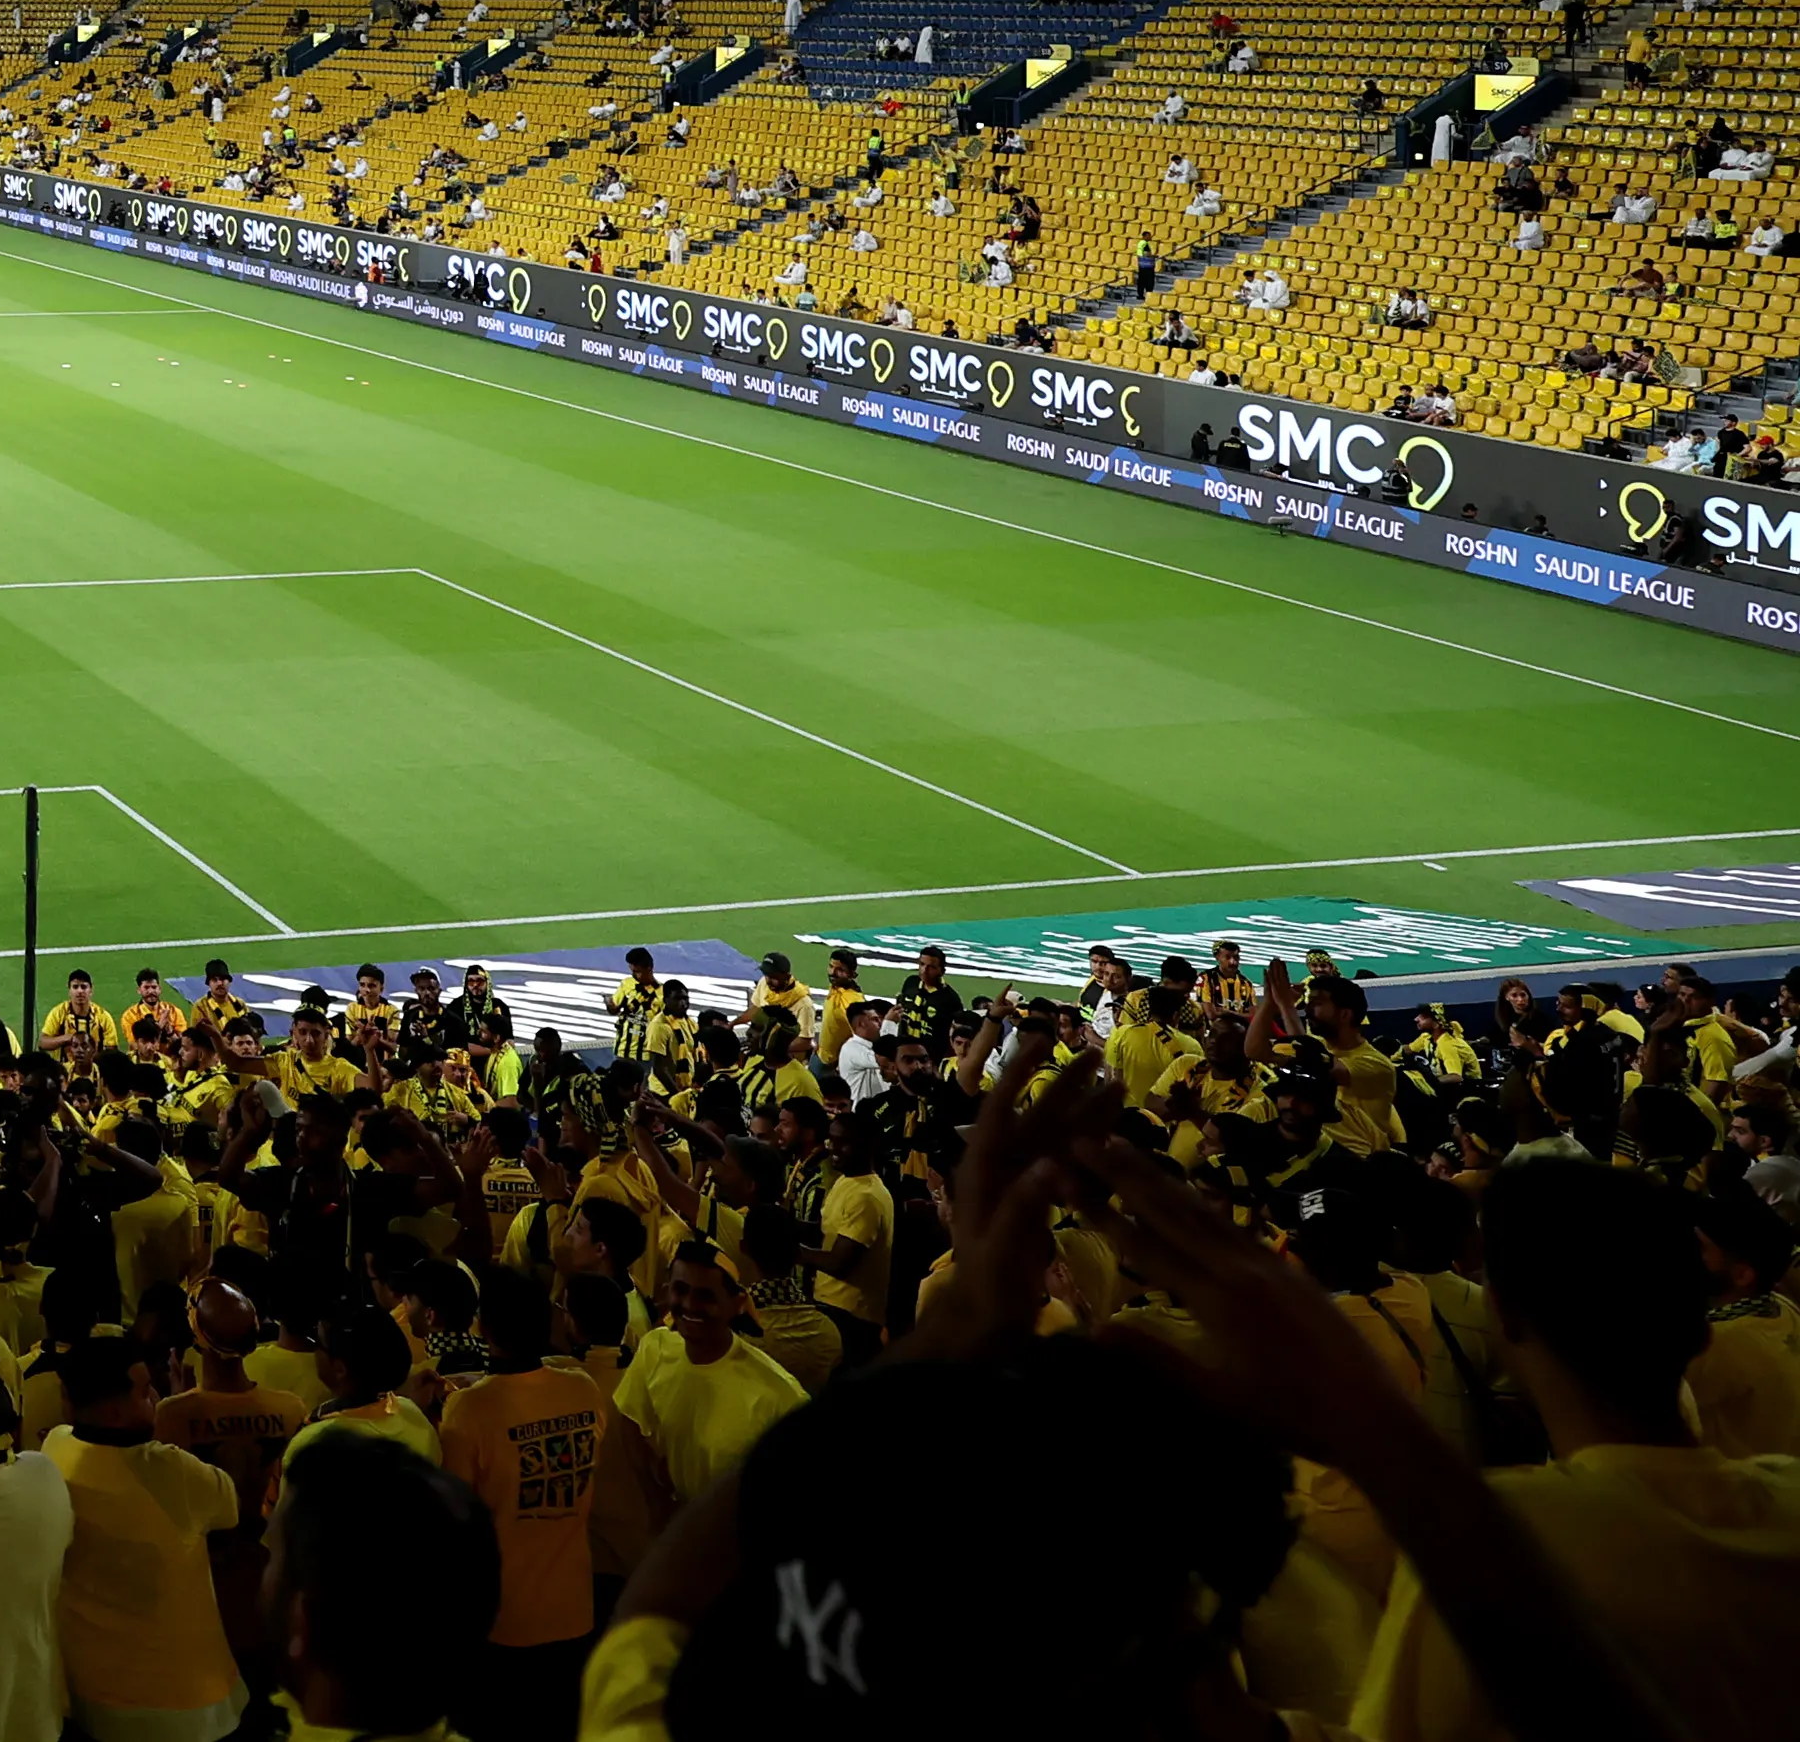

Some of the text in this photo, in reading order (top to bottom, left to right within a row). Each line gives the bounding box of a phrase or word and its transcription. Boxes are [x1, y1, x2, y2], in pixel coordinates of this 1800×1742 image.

[1494, 61, 1509, 71] S19
[1491, 88, 1511, 96] SMC
[4, 174, 27, 197] SMC
[54, 181, 88, 214] SMC
[193, 209, 225, 237] SMC
[243, 218, 277, 247] SMC
[297, 228, 334, 259] SMC
[270, 268, 351, 298] ROSHN SAUDI LEAGUE
[616, 289, 669, 328] SMC
[703, 306, 763, 348] SMC
[477, 314, 566, 347] ROSHN SAUDI LEAGUE
[800, 324, 866, 369] SMC
[582, 339, 684, 375] ROSHN SAUDI LEAGUE
[909, 345, 982, 392] SMC
[701, 365, 819, 405] ROSHN SAUDI LEAGUE
[1031, 368, 1114, 419] SMC
[842, 396, 981, 443] ROSHN SAUDI LEAGUE
[1007, 433, 1172, 488] ROSHN SAUDI LEAGUE
[1238, 404, 1386, 485] SMC
[1203, 478, 1262, 509] ROSHN
[1275, 495, 1329, 524] SAUDI
[1335, 508, 1405, 542] LEAGUE
[1446, 533, 1695, 610] ROSHN SAUDI LEAGUE
[1747, 602, 1800, 635] ROS
